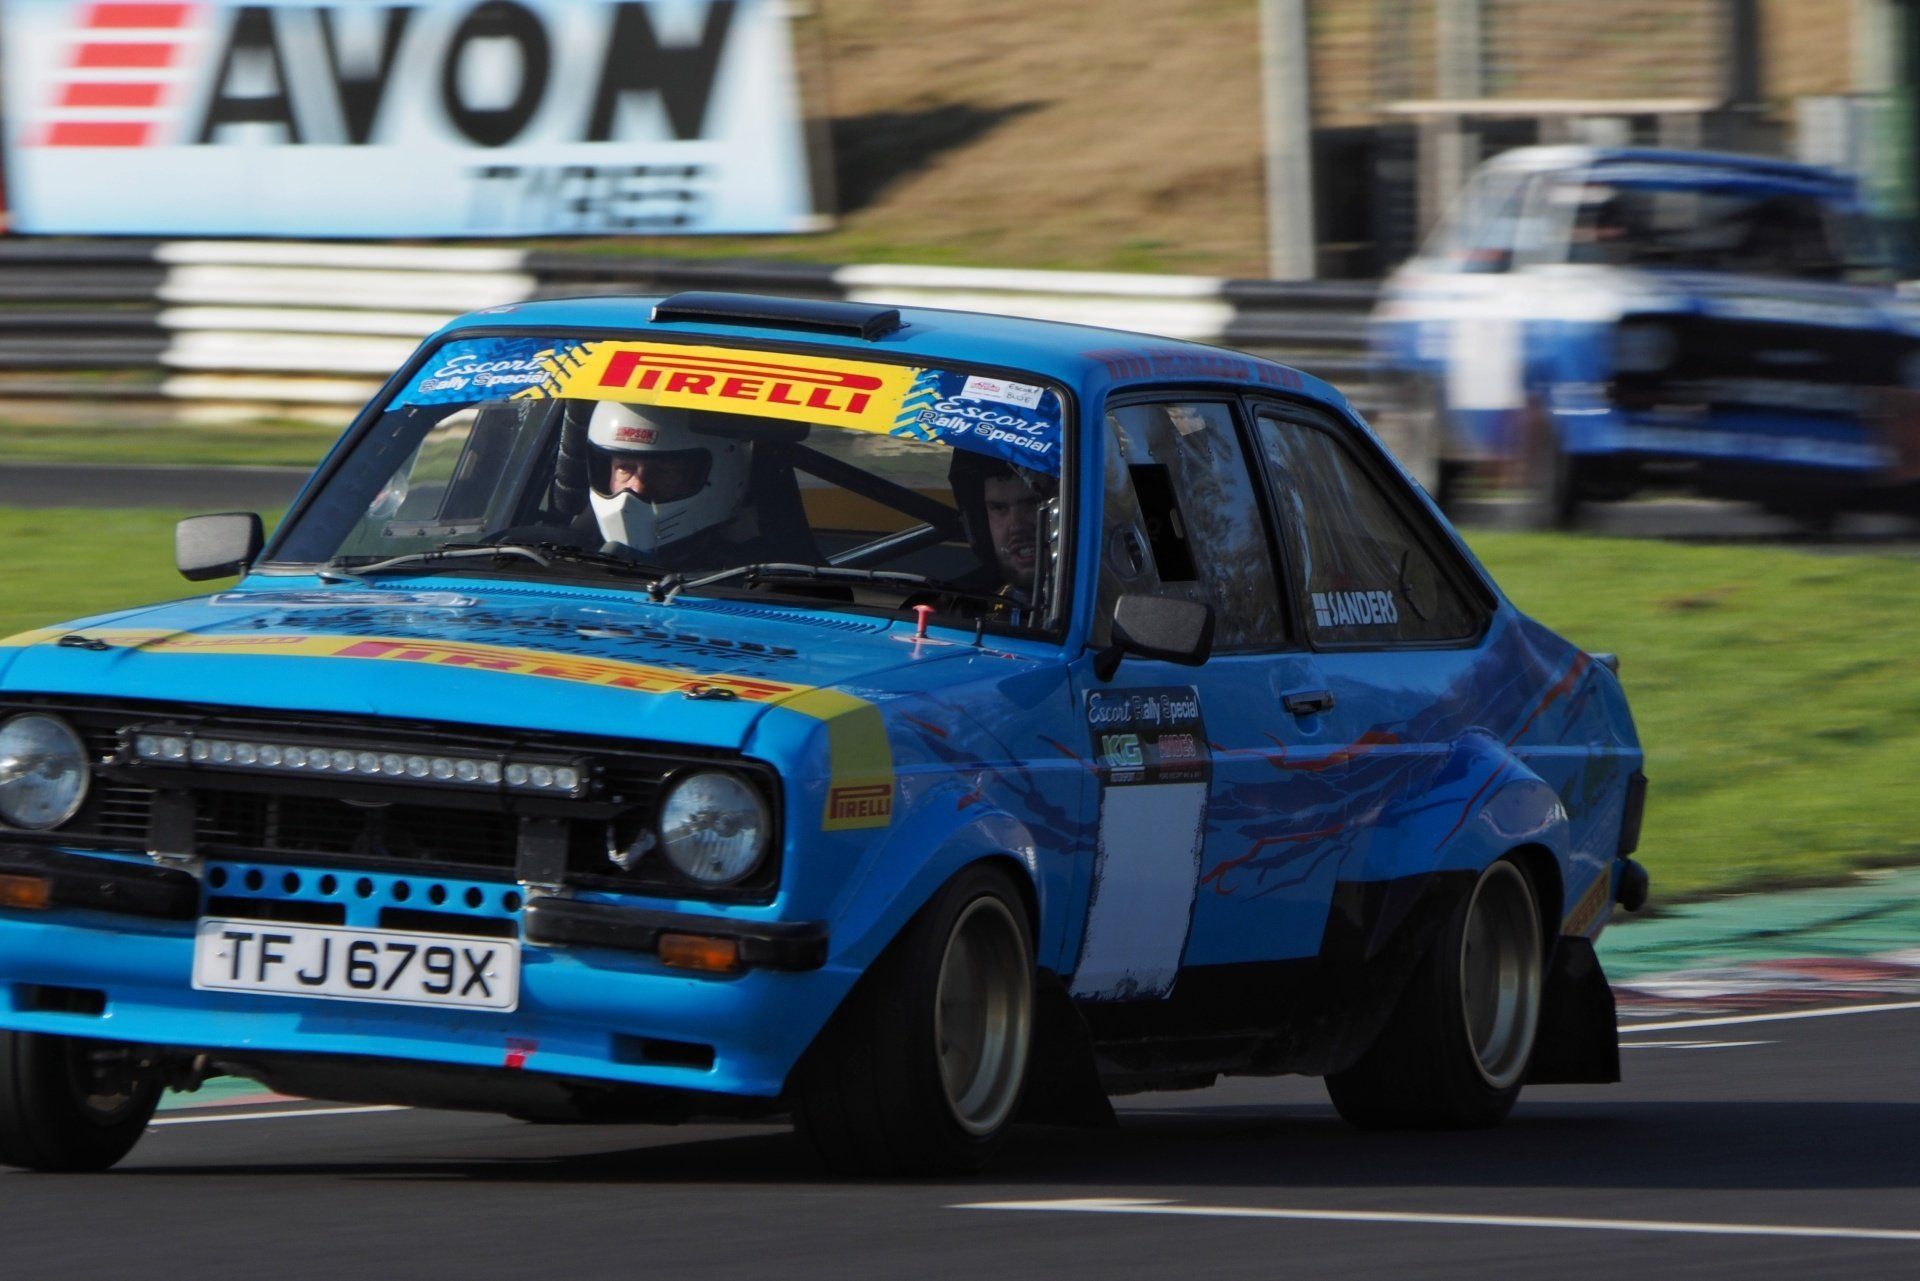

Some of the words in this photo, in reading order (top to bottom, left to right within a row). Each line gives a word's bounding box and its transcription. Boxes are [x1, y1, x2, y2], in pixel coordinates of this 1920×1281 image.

[200, 0, 736, 146] AVON
[418, 377, 467, 394] Rally
[473, 370, 552, 389] Special
[434, 354, 549, 379] Escort
[597, 350, 884, 415] PIRELLI
[917, 409, 973, 434] Rally
[974, 421, 1053, 454] Special
[934, 394, 1052, 436] Escort
[1327, 589, 1399, 625] SANDERS
[1088, 692, 1132, 724] Escort
[1132, 695, 1160, 725] Rally
[1160, 694, 1199, 725] Special
[1102, 733, 1143, 767] KG
[829, 784, 891, 820] PIRELLI
[222, 931, 331, 986] TFJ
[345, 940, 495, 998] 679X
